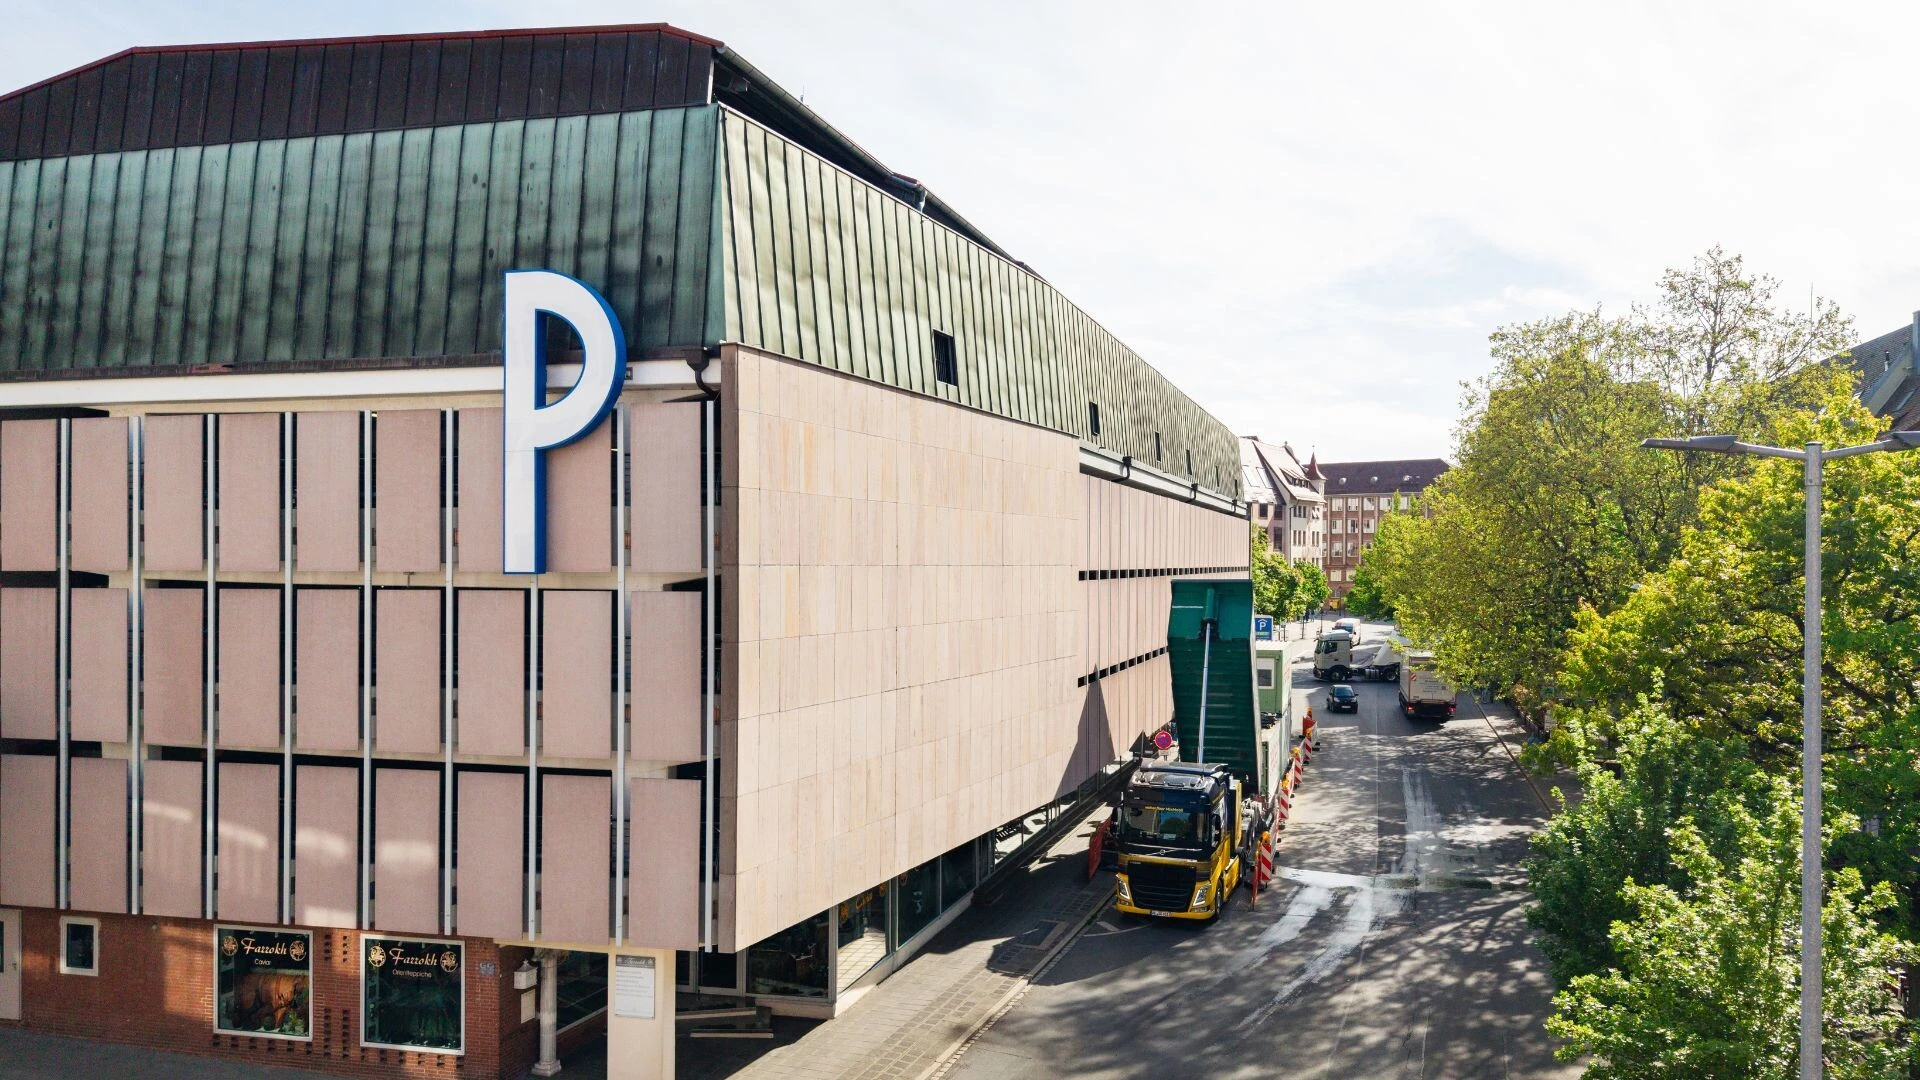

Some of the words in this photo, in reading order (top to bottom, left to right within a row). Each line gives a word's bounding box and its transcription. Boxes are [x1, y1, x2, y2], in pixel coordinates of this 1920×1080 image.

[503, 270, 626, 574] P
[1259, 621, 1266, 631] P
[240, 937, 287, 955] Farrokh
[389, 947, 438, 966] Farrokh
